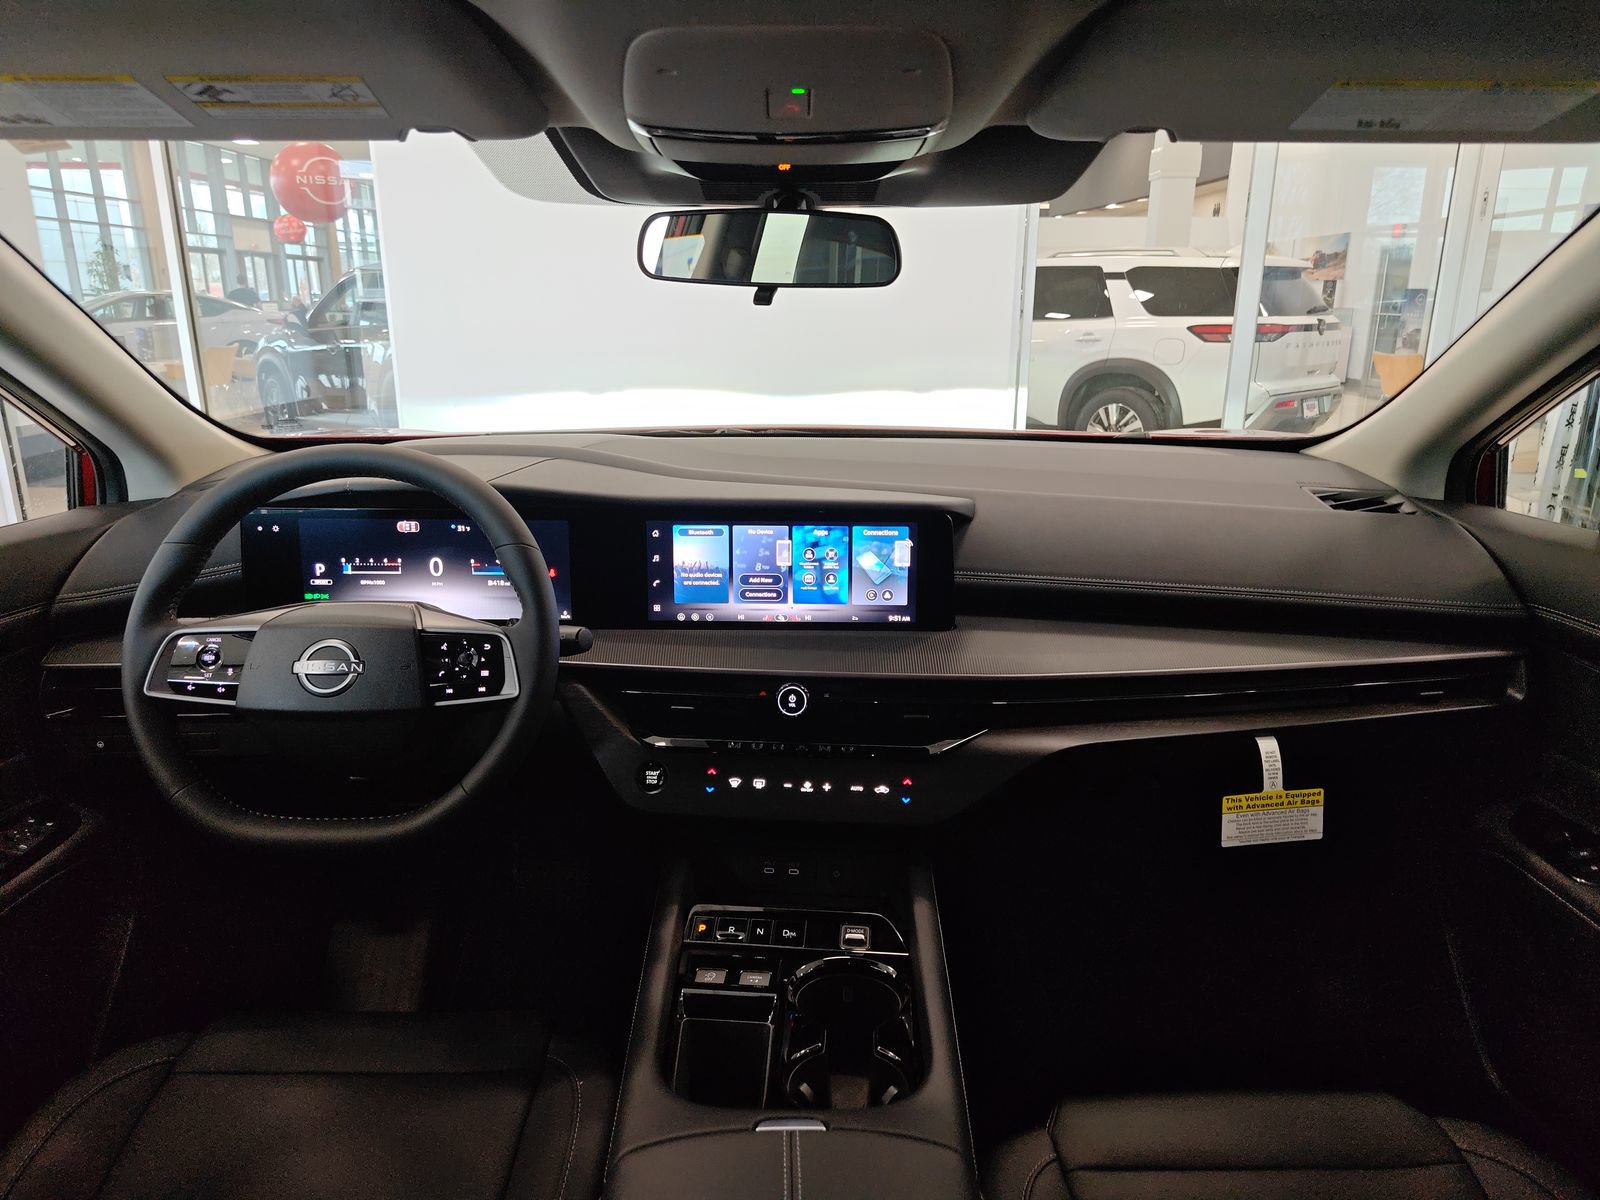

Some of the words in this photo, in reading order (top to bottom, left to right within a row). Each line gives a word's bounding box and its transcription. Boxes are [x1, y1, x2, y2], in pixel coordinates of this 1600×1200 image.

[778, 163, 791, 171] OFF
[315, 563, 325, 577] P
[429, 556, 444, 577] 0
[755, 562, 761, 572] 8
[295, 661, 364, 673] NISSAN
[1225, 796, 1243, 804] This
[1245, 794, 1274, 802] Vehicle
[1285, 790, 1322, 799] Equipped
[1246, 801, 1285, 809] Advanced
[1300, 798, 1320, 806] Bags
[698, 924, 706, 932] P
[728, 926, 735, 934] R
